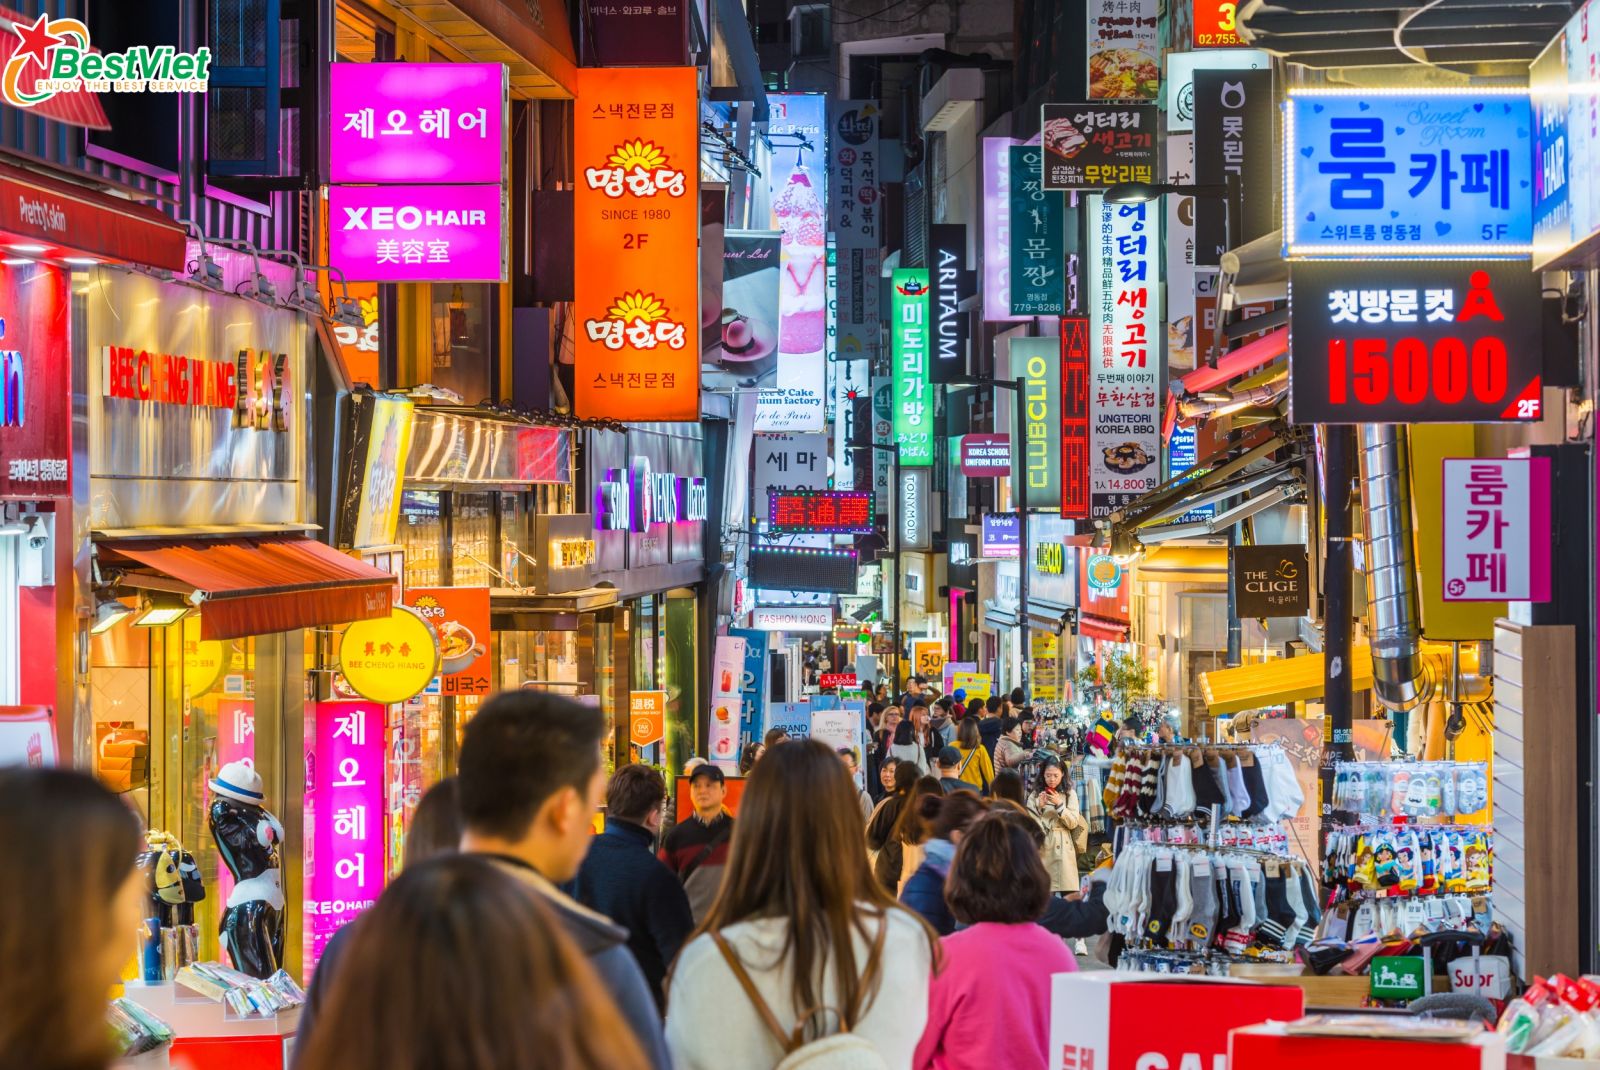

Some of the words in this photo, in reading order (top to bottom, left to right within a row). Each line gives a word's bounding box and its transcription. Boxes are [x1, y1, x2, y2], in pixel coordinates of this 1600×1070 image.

[1102, 1, 1141, 14] 烤牛肉
[592, 103, 674, 120] 스낵전문점
[343, 107, 488, 139] 제오헤어
[1074, 112, 1141, 133] 엉터리
[1092, 131, 1151, 153] 생고기
[1319, 118, 1396, 210] 룸
[1408, 149, 1510, 210] 카페
[586, 166, 685, 198] 명화당
[1085, 165, 1151, 184] 무한리필
[343, 206, 422, 230] XEO
[426, 210, 486, 226] HAIR
[601, 209, 639, 220] SINCE
[643, 209, 671, 220] 1980
[1321, 225, 1377, 241] 스위트룸
[1381, 225, 1421, 240] 명동점
[1481, 225, 1508, 240] 5F
[623, 234, 649, 249] 2F
[376, 238, 451, 264] 美容室
[1022, 238, 1054, 287] 몸짱
[939, 249, 957, 358] ARITAUM
[1014, 304, 1061, 312] 779-8286
[1328, 289, 1418, 323] 첫방문
[1424, 289, 1454, 323] 컷
[586, 319, 686, 349] 명화당
[1117, 288, 1147, 368] 생고기
[902, 302, 924, 426] 미도리가방
[1328, 336, 1508, 405] 15000
[109, 345, 135, 400] BEE
[137, 349, 189, 405] CHENG
[192, 359, 236, 409] HIANG
[593, 372, 675, 389] 스낵전문점
[1097, 374, 1124, 383] 두번째
[1126, 374, 1154, 383] 이야기
[789, 388, 814, 397] Cake
[1096, 391, 1155, 408] 무한삼겹
[784, 397, 821, 407] factory
[1517, 399, 1540, 417] 2F
[1099, 414, 1152, 424] UNGTEORI
[898, 432, 928, 443] みどり
[1095, 425, 1130, 434] KOREA
[1133, 425, 1155, 434] BBQ
[900, 446, 929, 457] かばん
[968, 448, 986, 456] KOREA
[987, 448, 1009, 456] SCHOOL
[965, 458, 990, 466] UNIFORM
[991, 458, 1010, 466] RENTA
[652, 473, 676, 523] VENUS
[905, 474, 915, 543] TONYMOLY
[1465, 465, 1509, 592] 룸카페
[1244, 571, 1268, 580] THE
[1245, 580, 1298, 593] CLIGE
[1450, 581, 1464, 594] 5F
[758, 615, 797, 624] FASHION
[349, 660, 363, 669] BEE
[364, 661, 395, 669] CHENG
[398, 662, 425, 670] HIANG
[920, 653, 940, 668] 50
[631, 698, 655, 710] 退税
[332, 710, 366, 888] 제오헤어
